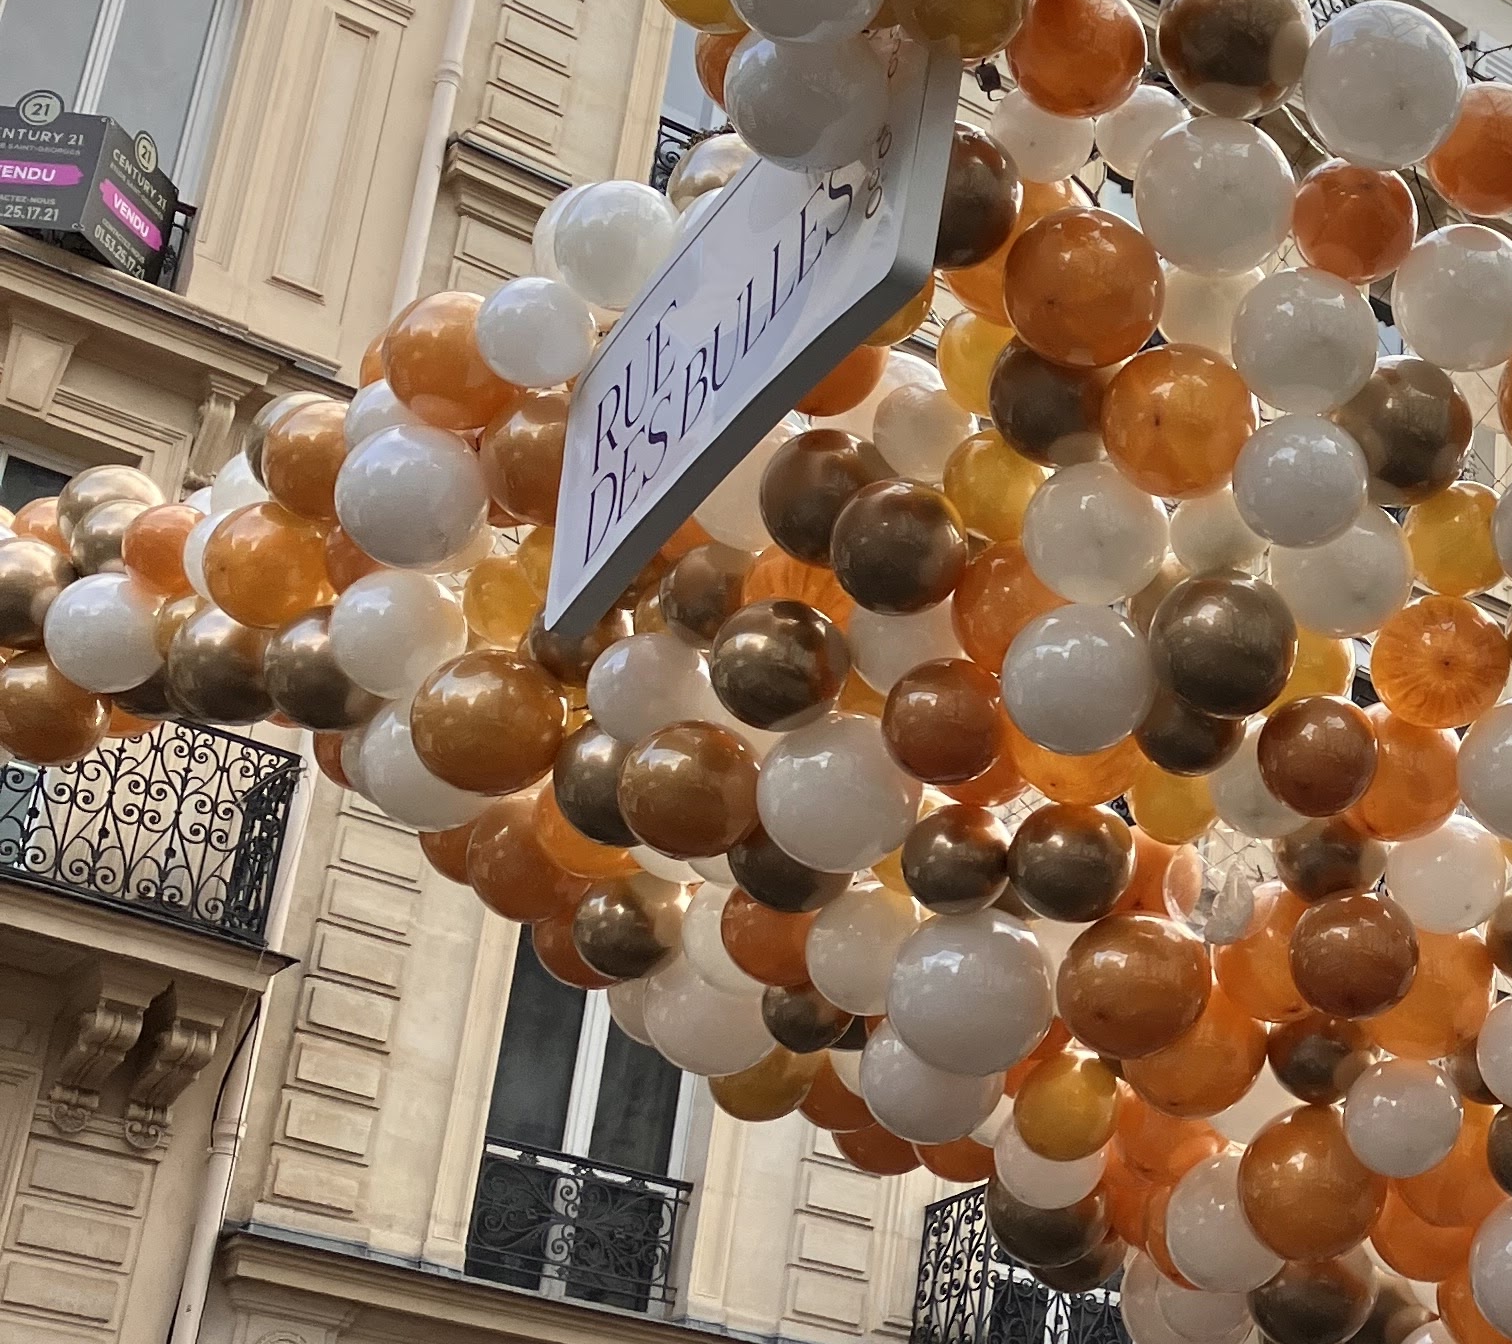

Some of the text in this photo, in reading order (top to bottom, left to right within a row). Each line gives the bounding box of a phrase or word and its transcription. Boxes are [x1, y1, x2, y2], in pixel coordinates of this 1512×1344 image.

[30, 103, 51, 117] 21
[0, 127, 84, 146] NTURY 21
[140, 146, 152, 164] 21
[0, 165, 56, 182] ENDU
[113, 149, 157, 197] CENTURY
[157, 195, 168, 210] 21
[113, 193, 149, 238] VENDU
[582, 165, 853, 568] DES BULLES
[594, 300, 677, 475] RUE
